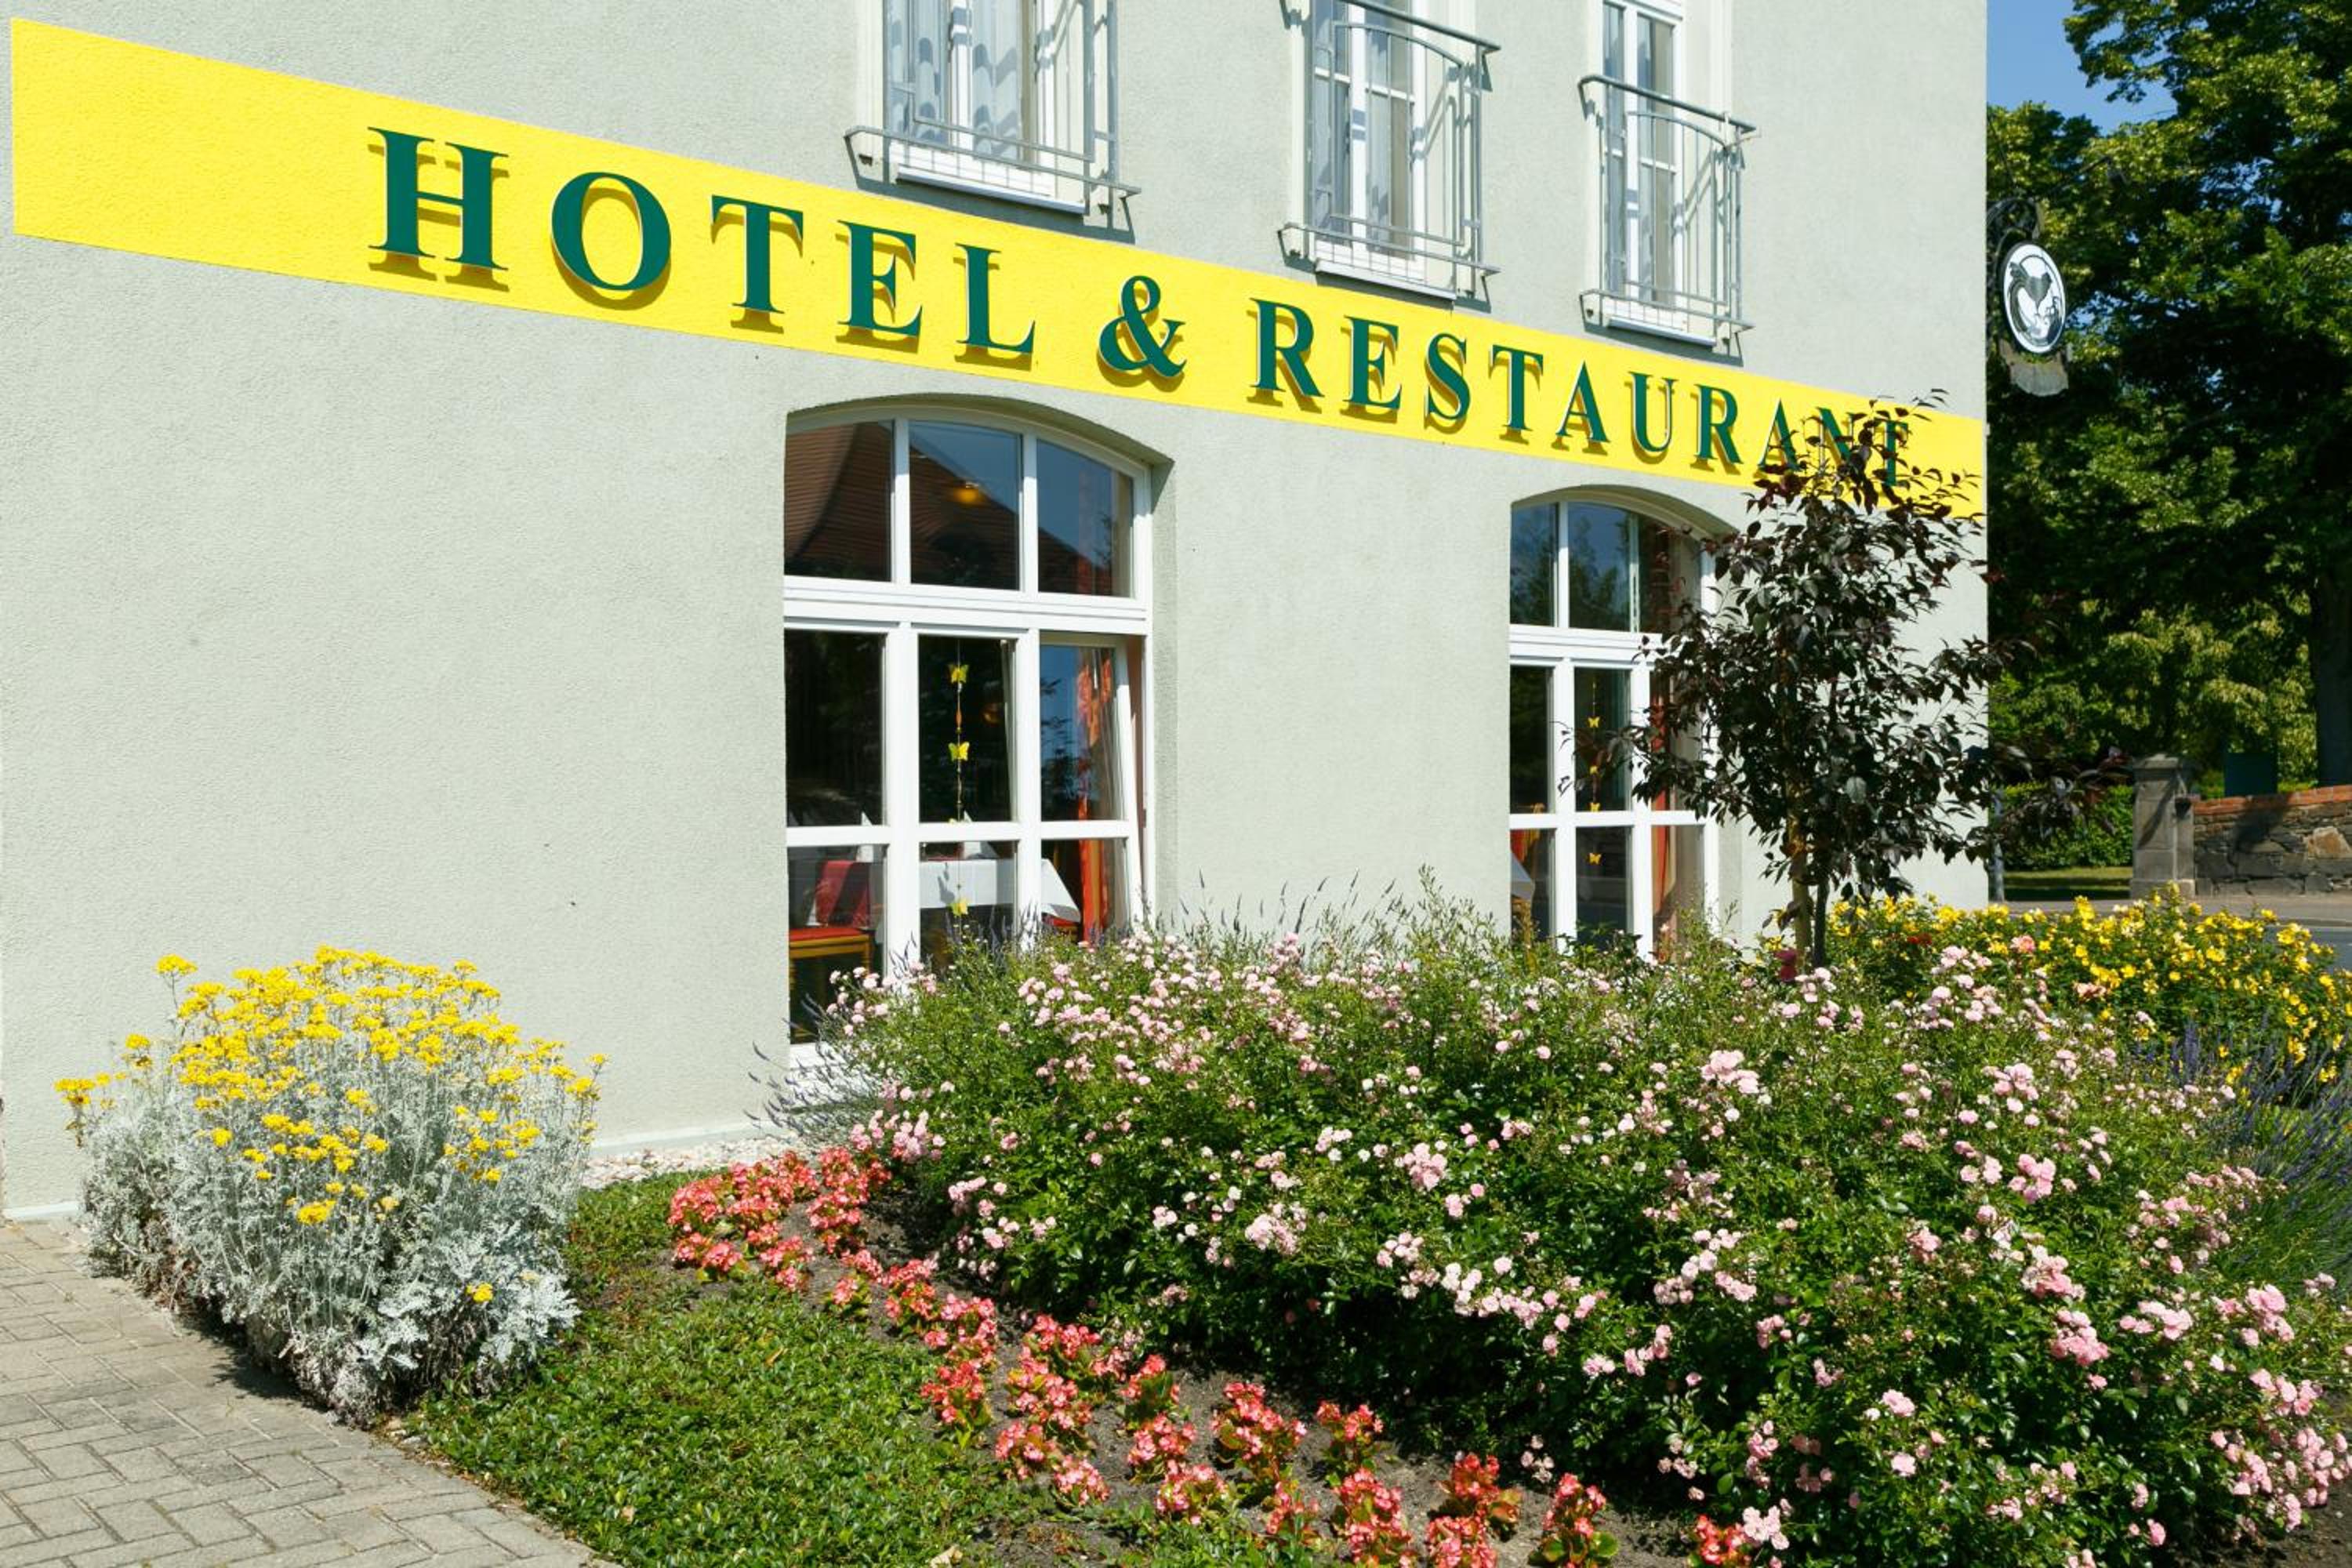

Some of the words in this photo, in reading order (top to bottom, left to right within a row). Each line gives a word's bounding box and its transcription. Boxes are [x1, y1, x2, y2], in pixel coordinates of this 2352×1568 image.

[368, 126, 1036, 355] HOTEL
[1098, 274, 1188, 379] &
[1249, 297, 1910, 489] RESTAURANT
